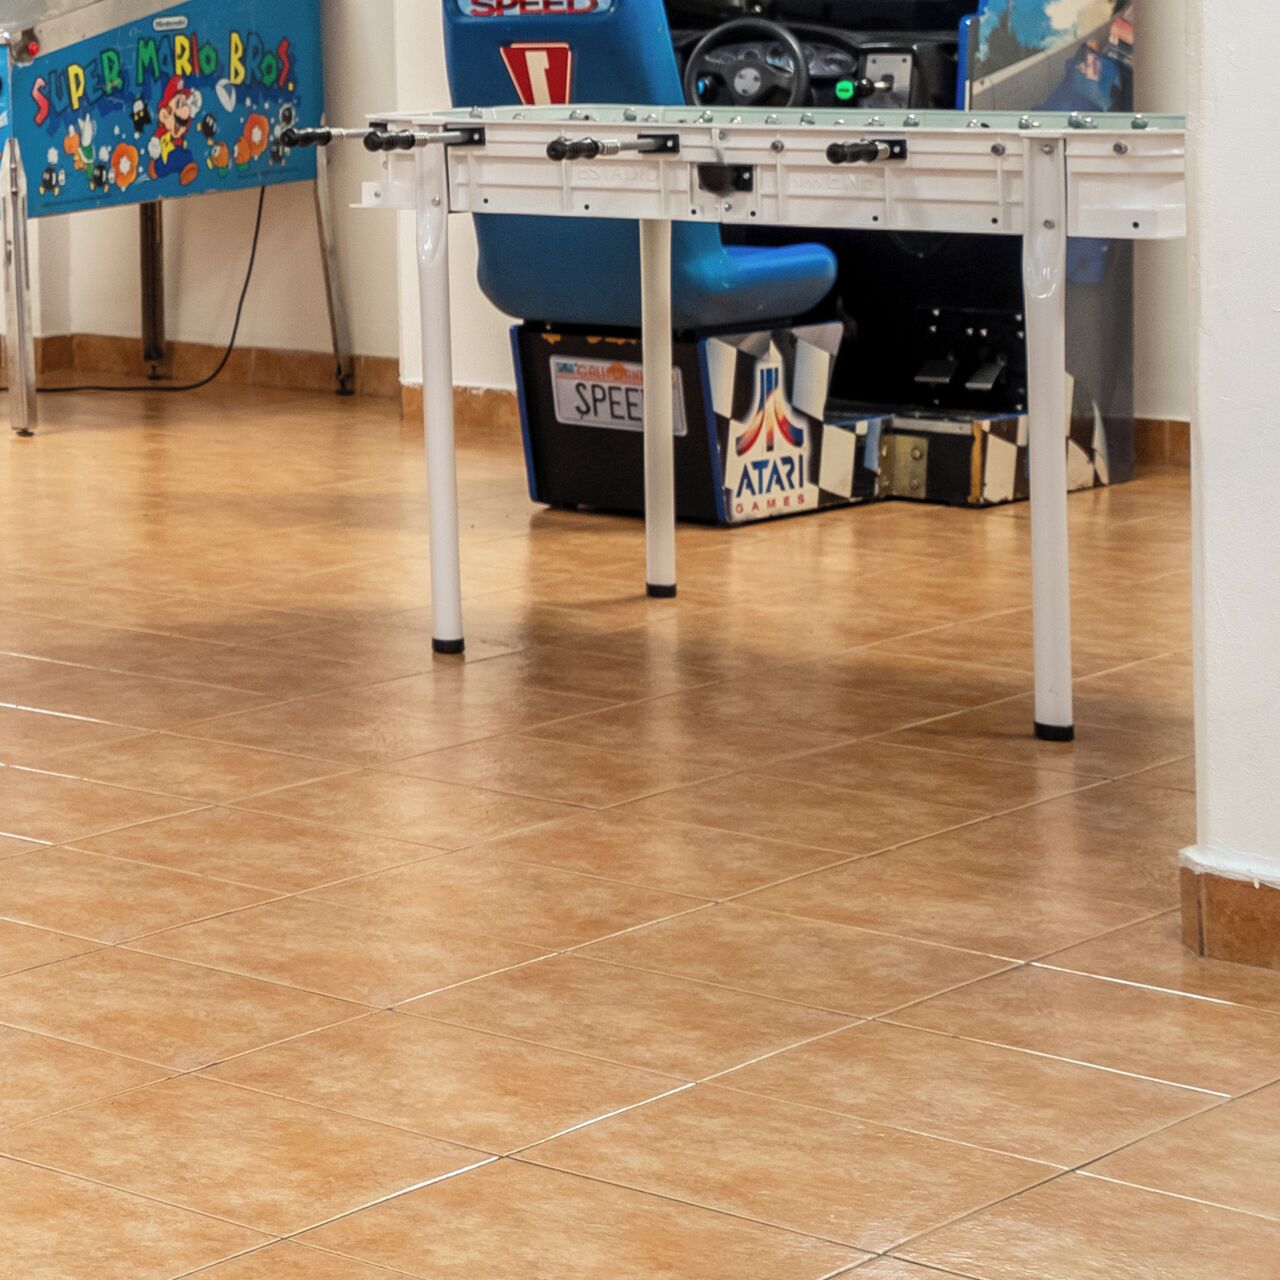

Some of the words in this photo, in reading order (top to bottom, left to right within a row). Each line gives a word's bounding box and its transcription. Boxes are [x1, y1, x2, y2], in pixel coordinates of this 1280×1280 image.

[32, 48, 123, 125] SUPER
[136, 33, 218, 87] MARIO
[575, 382, 644, 420] SPEE
[736, 454, 803, 498] ATARI
[736, 494, 804, 514] GAMES
